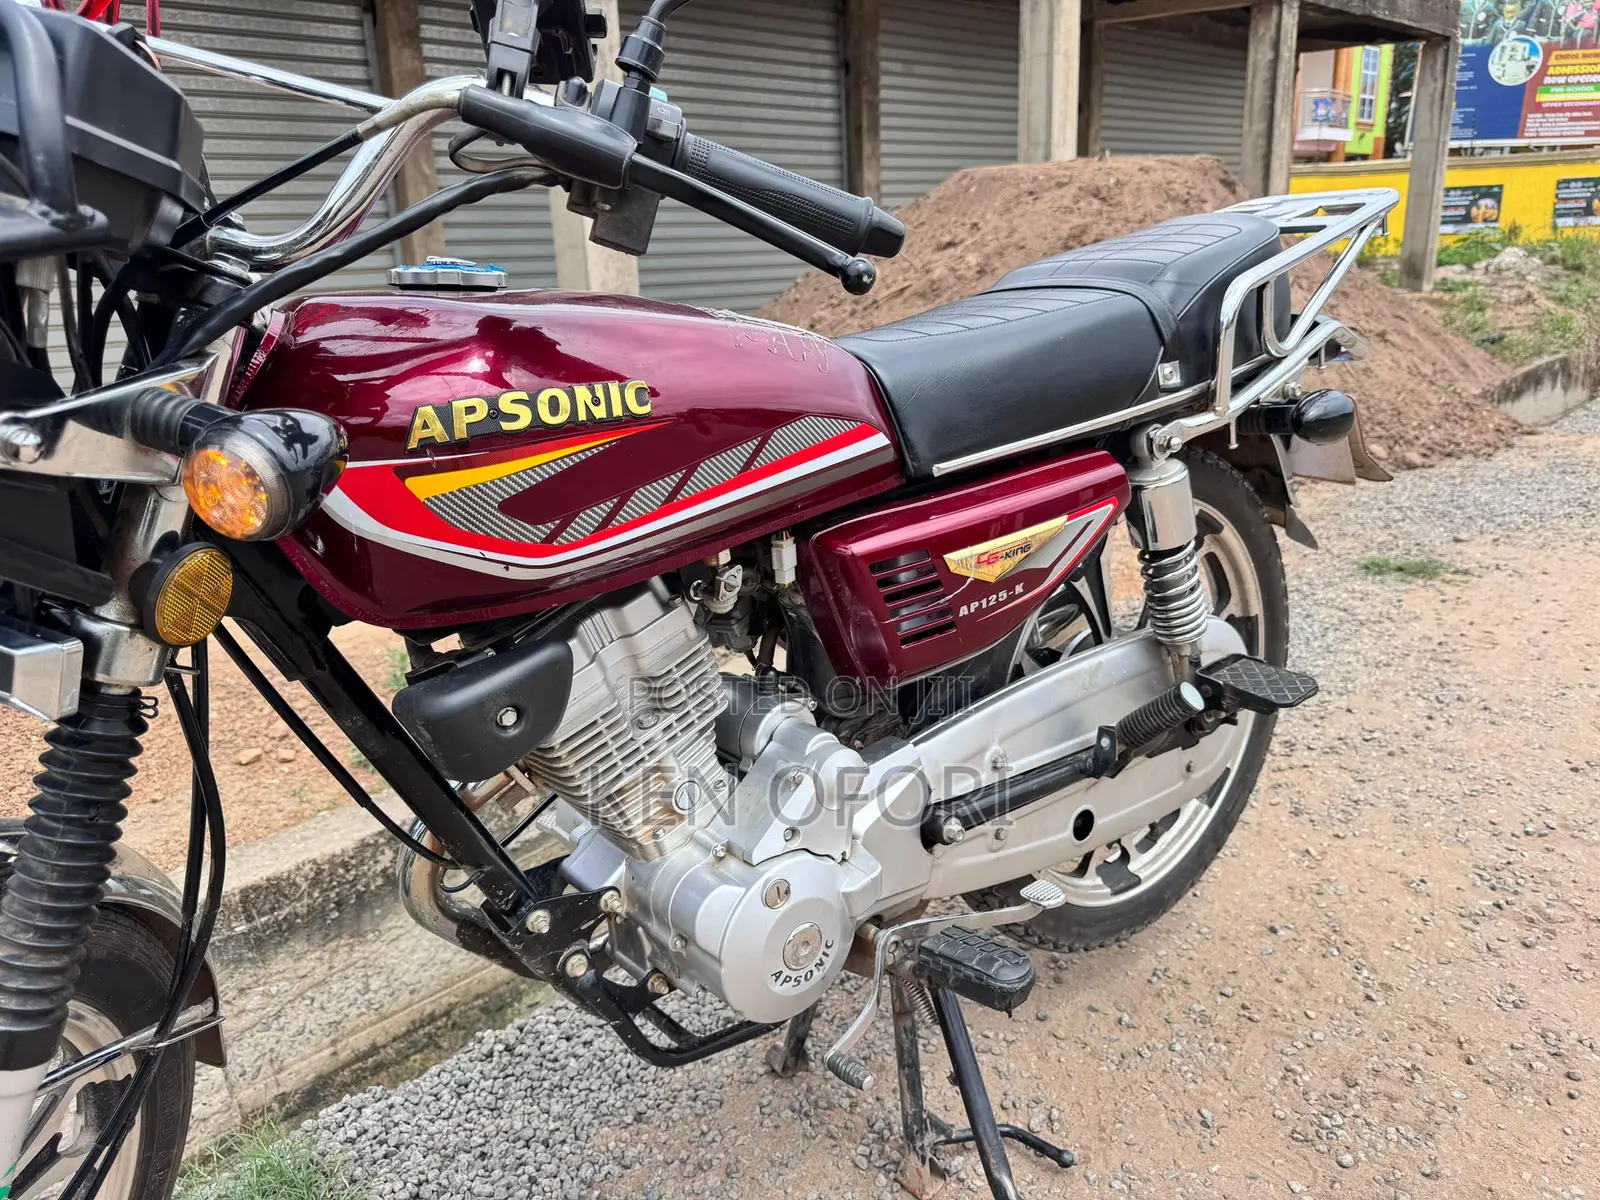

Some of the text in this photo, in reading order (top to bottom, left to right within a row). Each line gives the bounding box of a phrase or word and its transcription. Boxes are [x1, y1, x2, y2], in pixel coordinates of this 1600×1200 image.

[407, 380, 652, 451] APSONIC
[959, 582, 1025, 618] AP125-K
[770, 939, 835, 988] APSONIC
